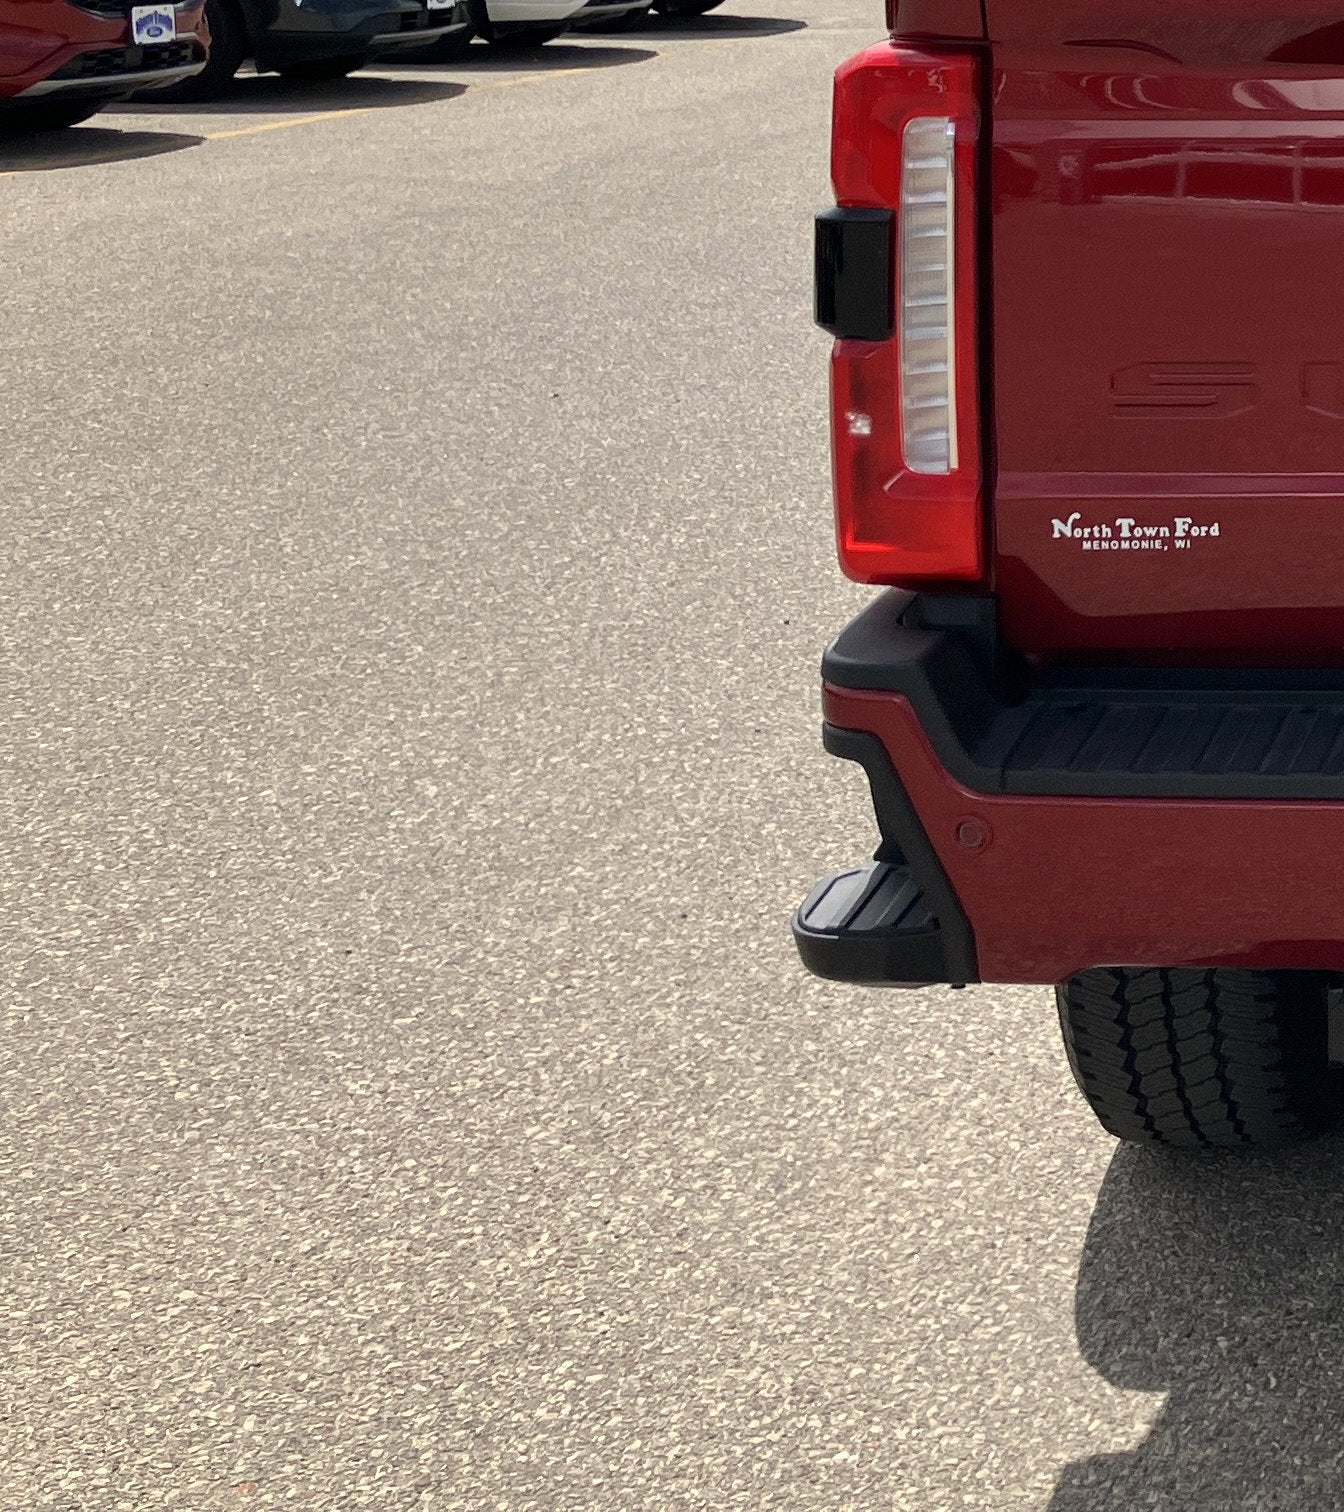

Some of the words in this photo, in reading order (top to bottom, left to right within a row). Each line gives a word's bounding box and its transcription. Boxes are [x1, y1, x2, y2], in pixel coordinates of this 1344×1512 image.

[1051, 512, 1112, 538] North
[1115, 517, 1171, 538] Town
[1174, 517, 1220, 537] Ford
[1082, 540, 1169, 551] MENOMONIE,
[1174, 539, 1191, 549] WI
